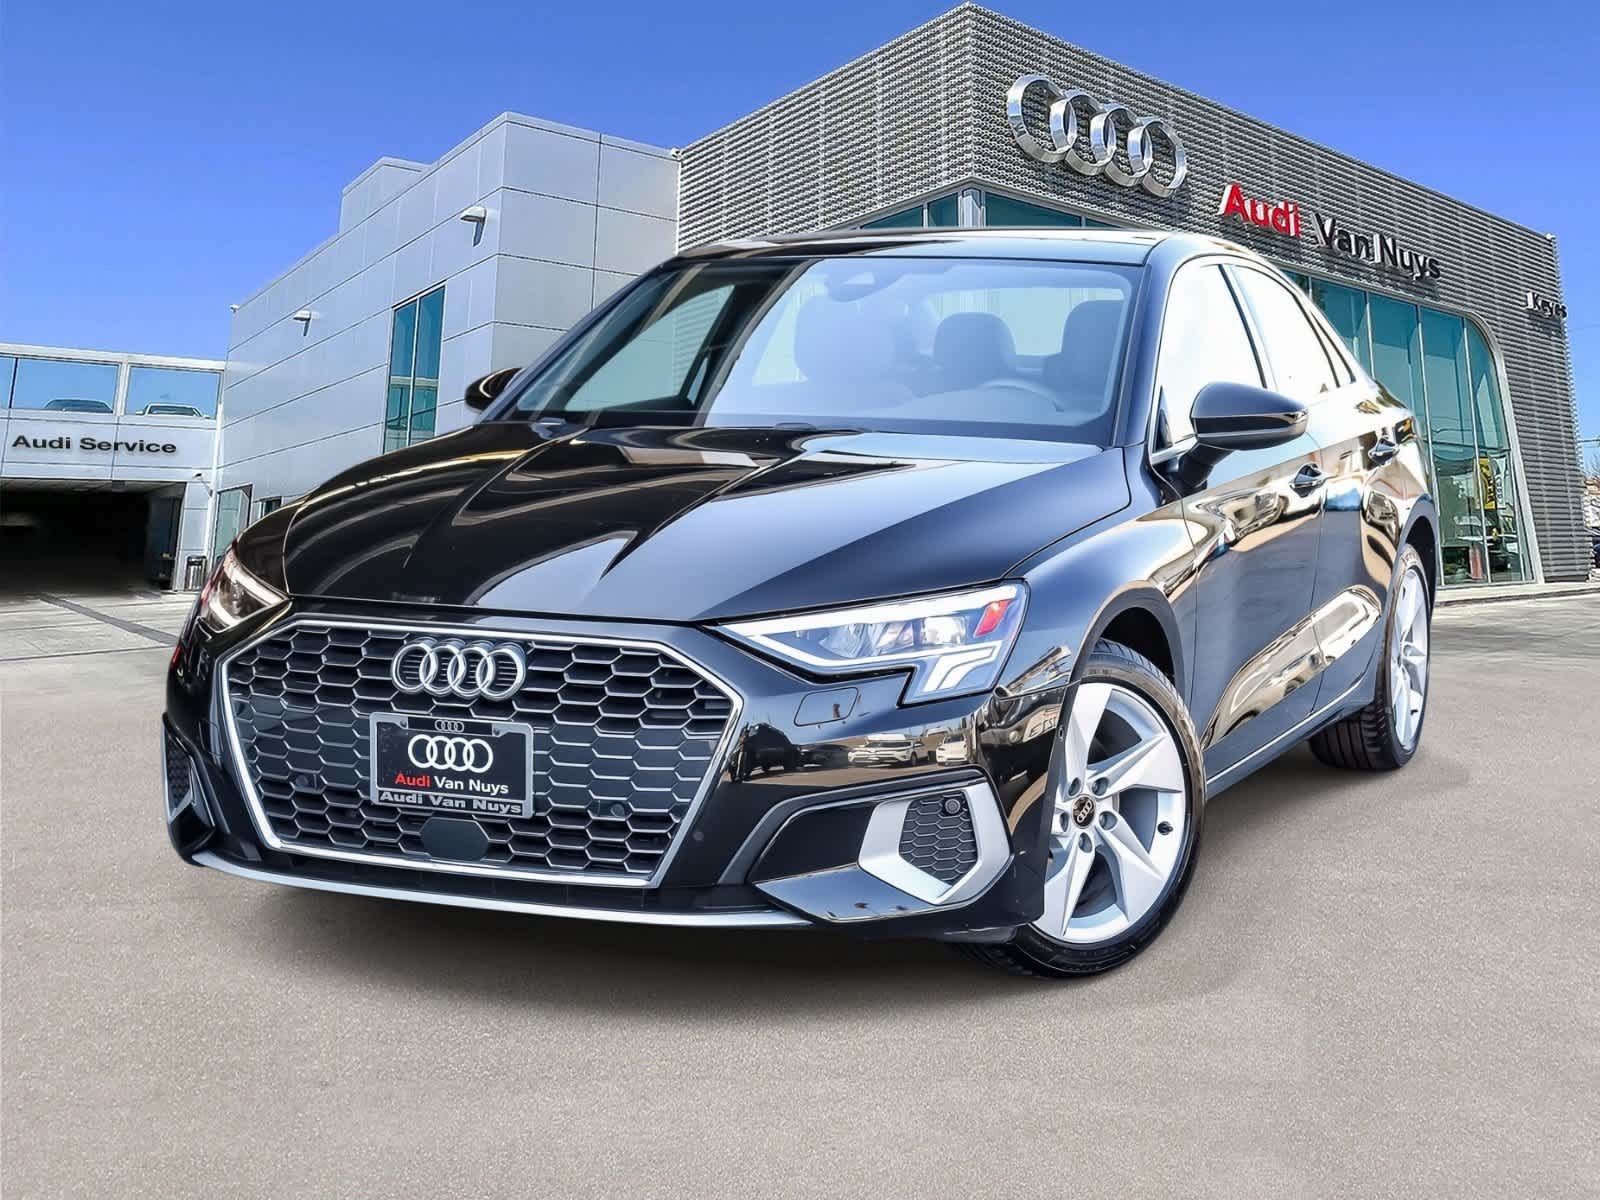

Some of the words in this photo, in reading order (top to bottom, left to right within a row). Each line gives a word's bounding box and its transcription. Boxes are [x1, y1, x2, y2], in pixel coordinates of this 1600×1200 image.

[1219, 182, 1301, 238] Audi
[1311, 211, 1369, 258] Van
[1374, 233, 1441, 280] Nuys
[12, 435, 71, 449] Audi
[80, 437, 177, 453] Service
[395, 772, 431, 787] Audi
[434, 776, 464, 790] Van
[469, 779, 509, 796] Nuys
[380, 791, 423, 804] Audi
[429, 795, 466, 809] Van
[472, 799, 522, 815] Nuys
